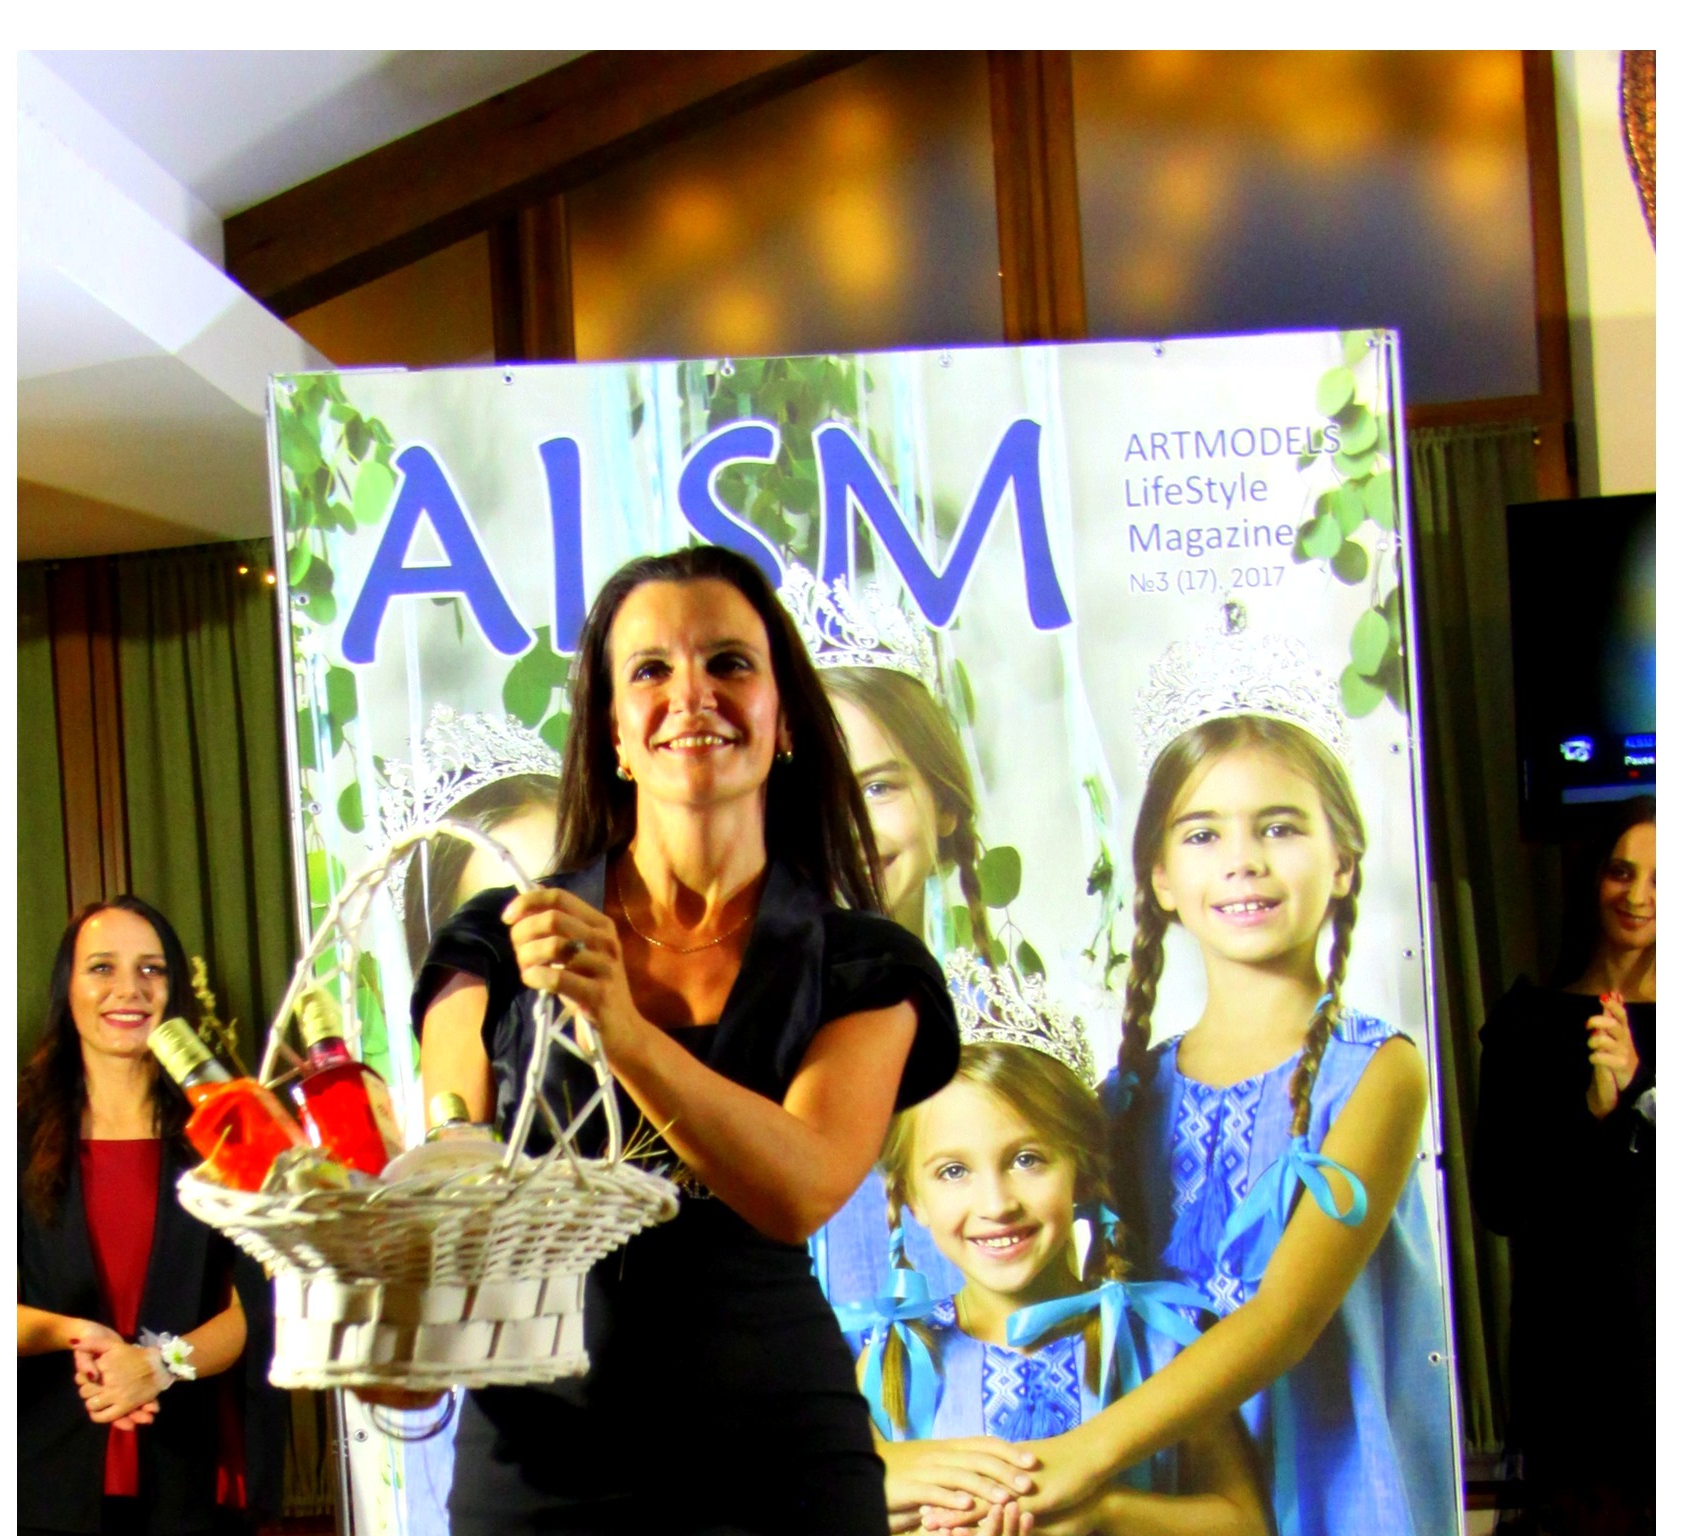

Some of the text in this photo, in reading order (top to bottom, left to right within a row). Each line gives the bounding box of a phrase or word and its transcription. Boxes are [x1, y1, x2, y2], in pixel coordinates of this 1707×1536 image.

[1124, 424, 1341, 463] ARTMODELS
[1124, 471, 1268, 510] LifeStyle
[1128, 517, 1294, 558] Magazine
[1129, 571, 1170, 593] №3
[1232, 566, 1286, 589] 2017
